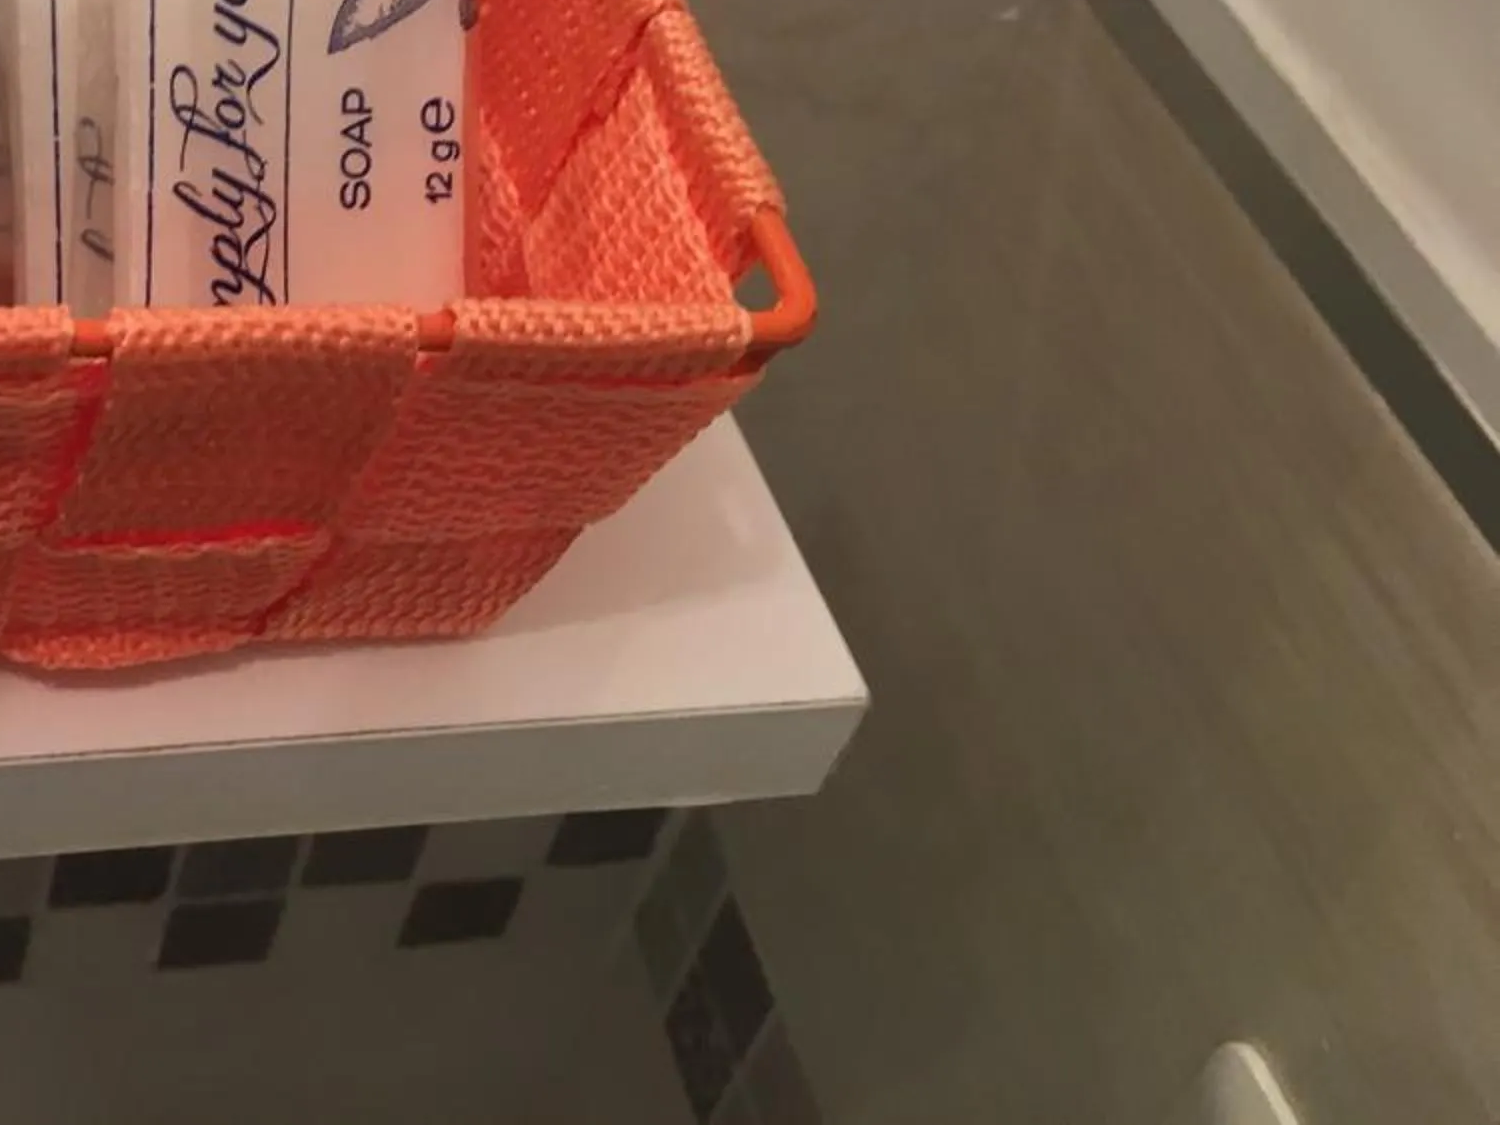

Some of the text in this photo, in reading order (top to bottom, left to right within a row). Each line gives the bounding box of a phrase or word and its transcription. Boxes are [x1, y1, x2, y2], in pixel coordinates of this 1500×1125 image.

[168, 63, 267, 180] for
[340, 88, 373, 210] SOAP
[431, 140, 462, 165] g
[424, 169, 455, 205] 12
